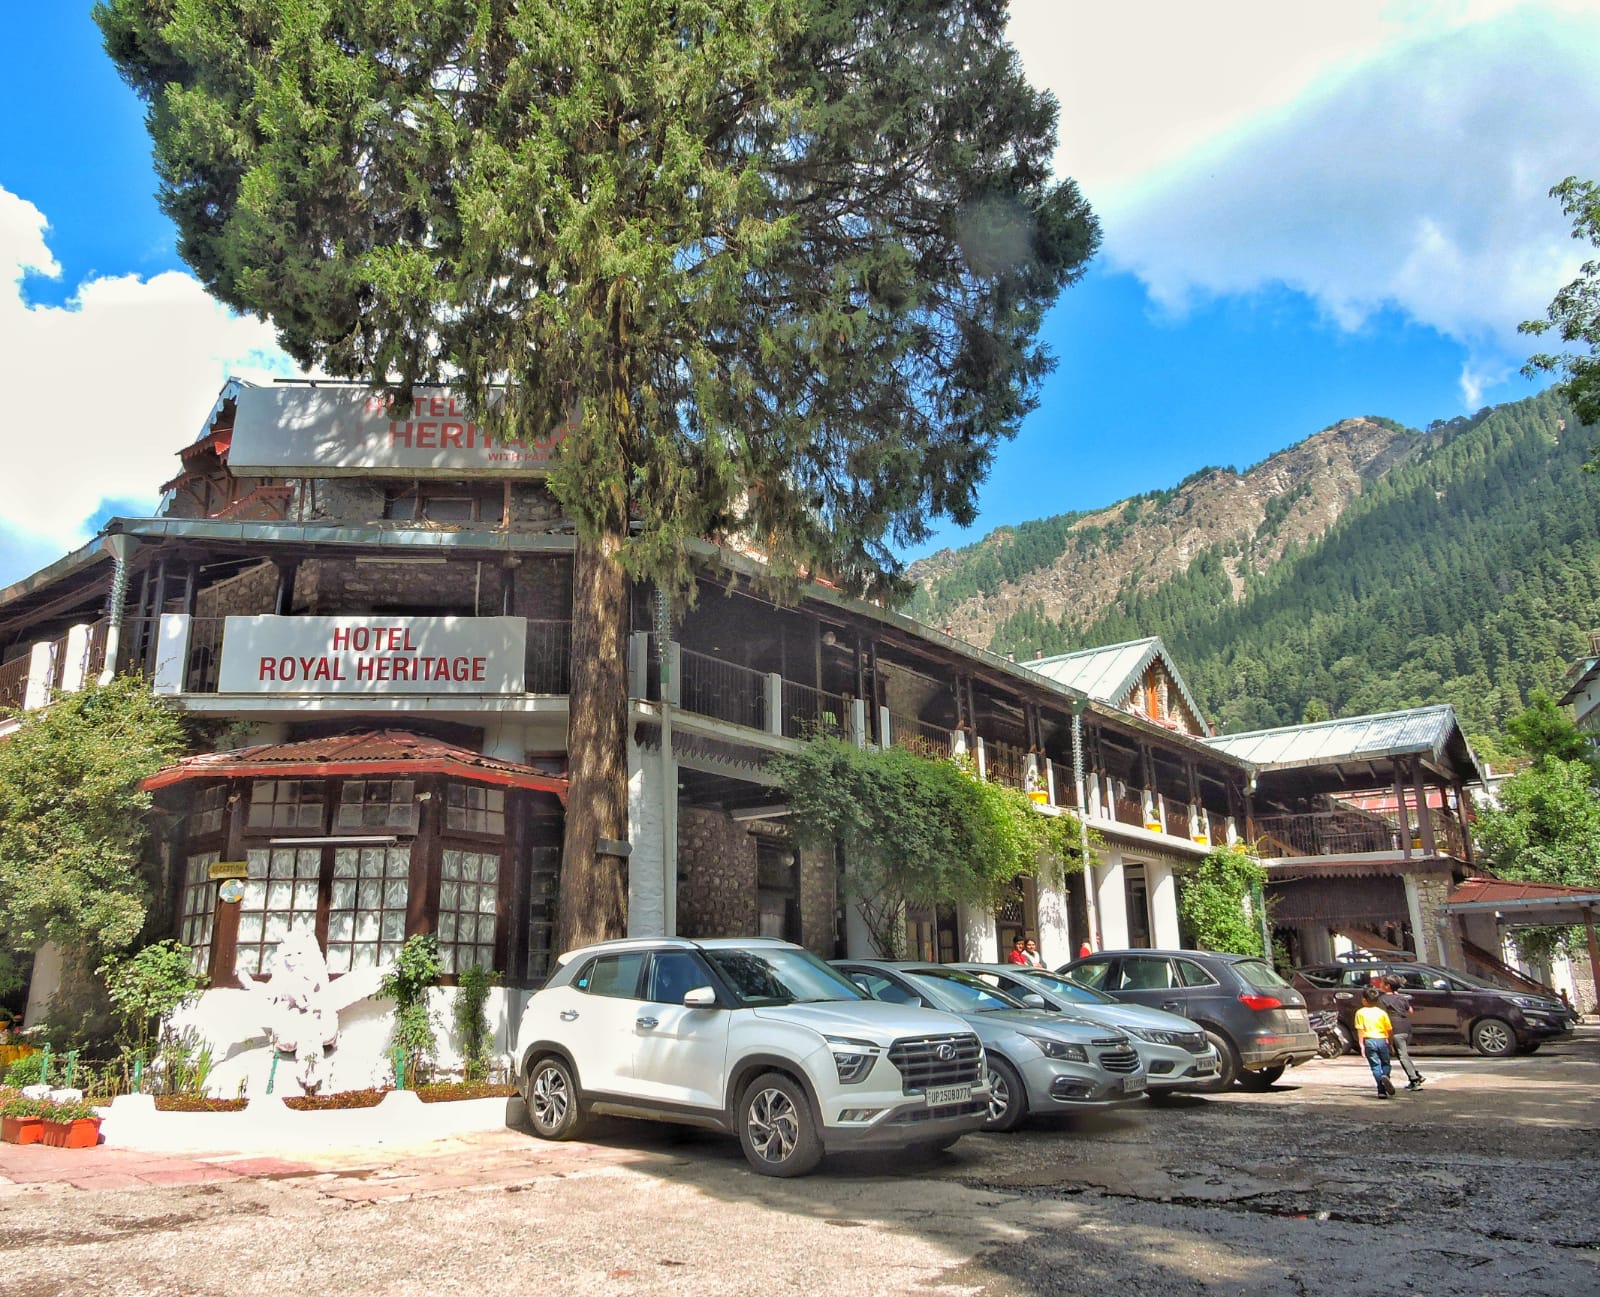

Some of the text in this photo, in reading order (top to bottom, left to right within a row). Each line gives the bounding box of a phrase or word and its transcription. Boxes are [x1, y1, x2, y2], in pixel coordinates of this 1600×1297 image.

[364, 397, 464, 417] HTEL
[488, 452, 549, 462] WITH PAR
[332, 626, 417, 652] HOTEL
[258, 656, 487, 682] ROYAL HERITAGE
